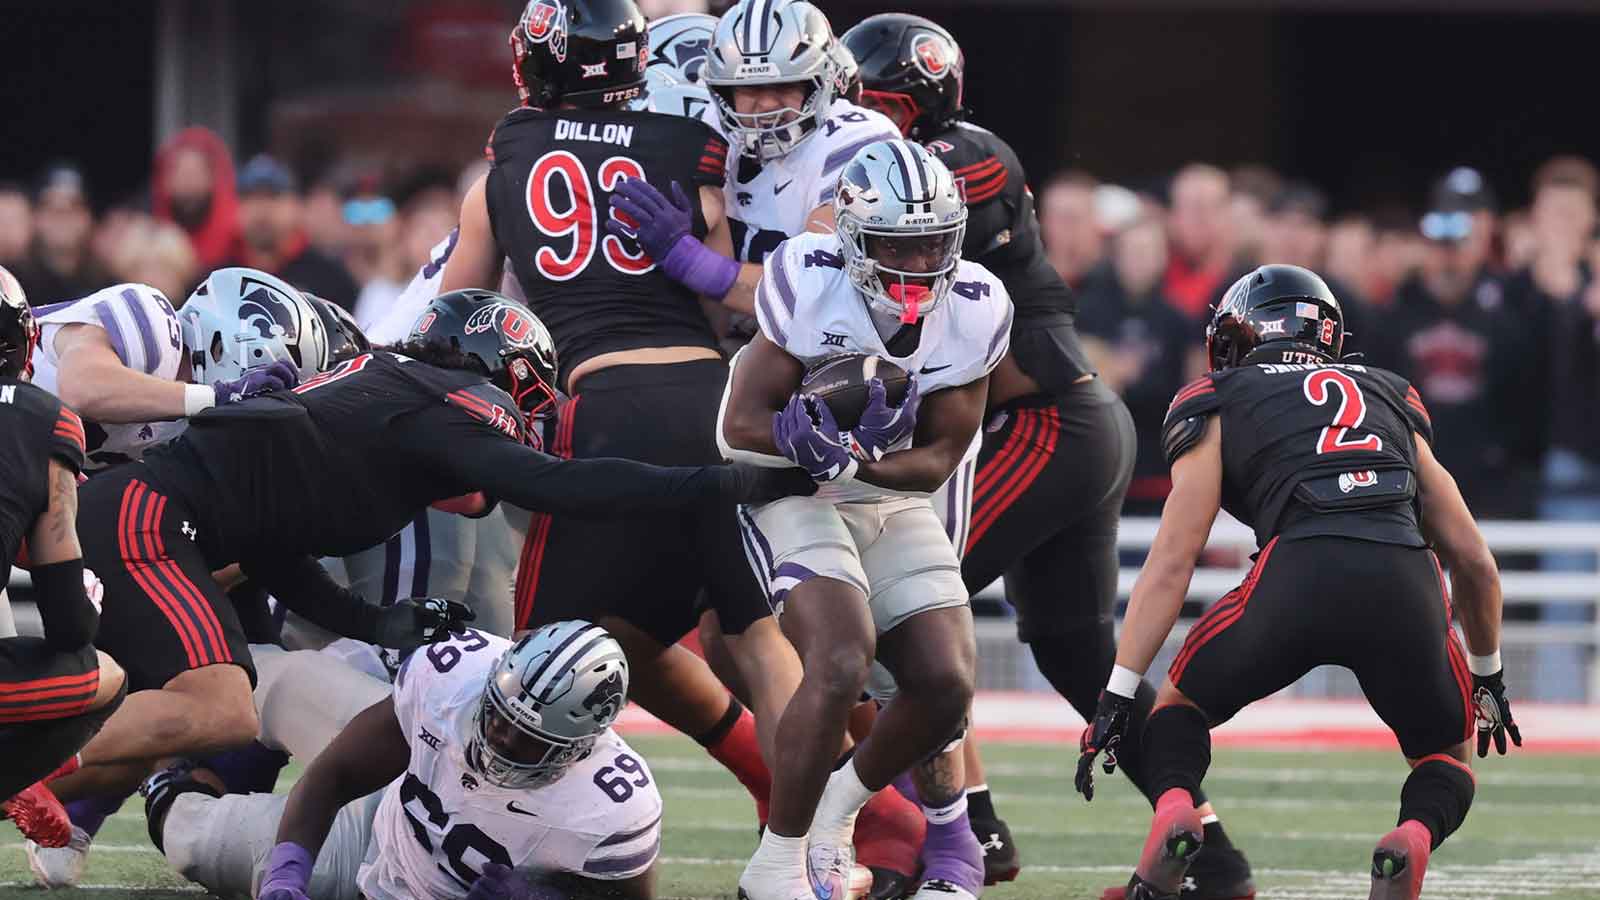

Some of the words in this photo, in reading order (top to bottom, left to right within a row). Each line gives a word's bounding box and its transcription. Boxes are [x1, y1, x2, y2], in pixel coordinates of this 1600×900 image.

[603, 87, 640, 103] UTES
[554, 119, 633, 147] DILLON
[526, 150, 658, 281] 93
[905, 217, 935, 225] K-STATE
[804, 249, 843, 270] 4
[952, 281, 990, 301] 4
[1259, 318, 1286, 335] XII
[1320, 318, 1334, 345] 2
[820, 331, 848, 347] XII
[1282, 351, 1324, 366] UTES
[1303, 368, 1382, 454] 2
[426, 628, 489, 673] 69
[418, 726, 444, 751] XII
[593, 753, 649, 803] 69
